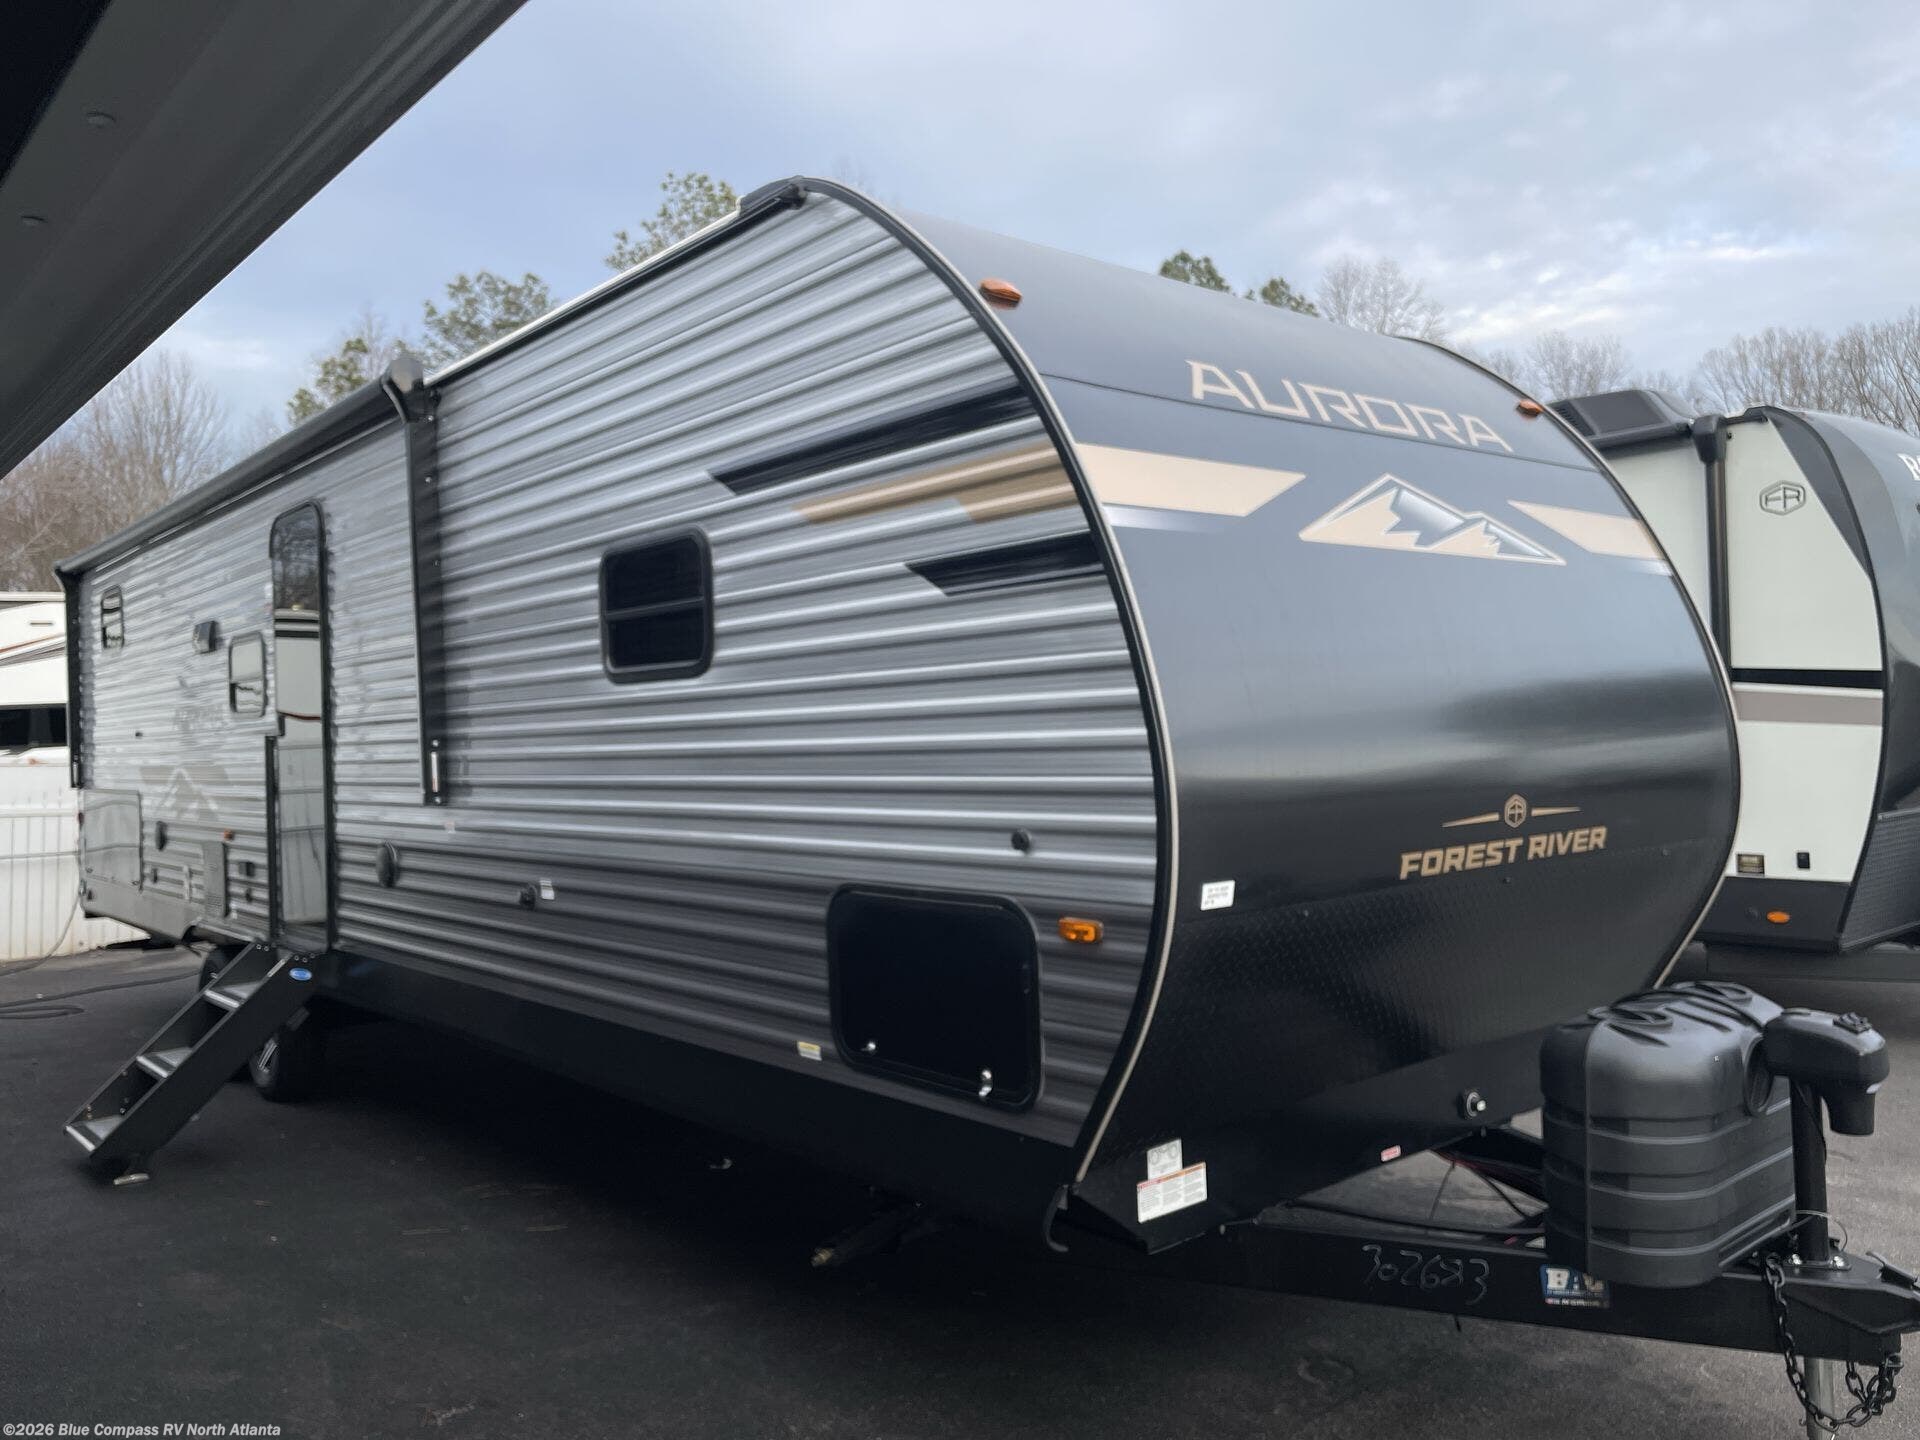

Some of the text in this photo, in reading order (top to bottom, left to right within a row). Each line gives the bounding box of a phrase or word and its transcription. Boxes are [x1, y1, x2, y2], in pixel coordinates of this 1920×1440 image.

[1184, 359, 1514, 453] AURORA
[1896, 452, 1920, 481] R
[1399, 825, 1608, 881] FOREST RIVER
